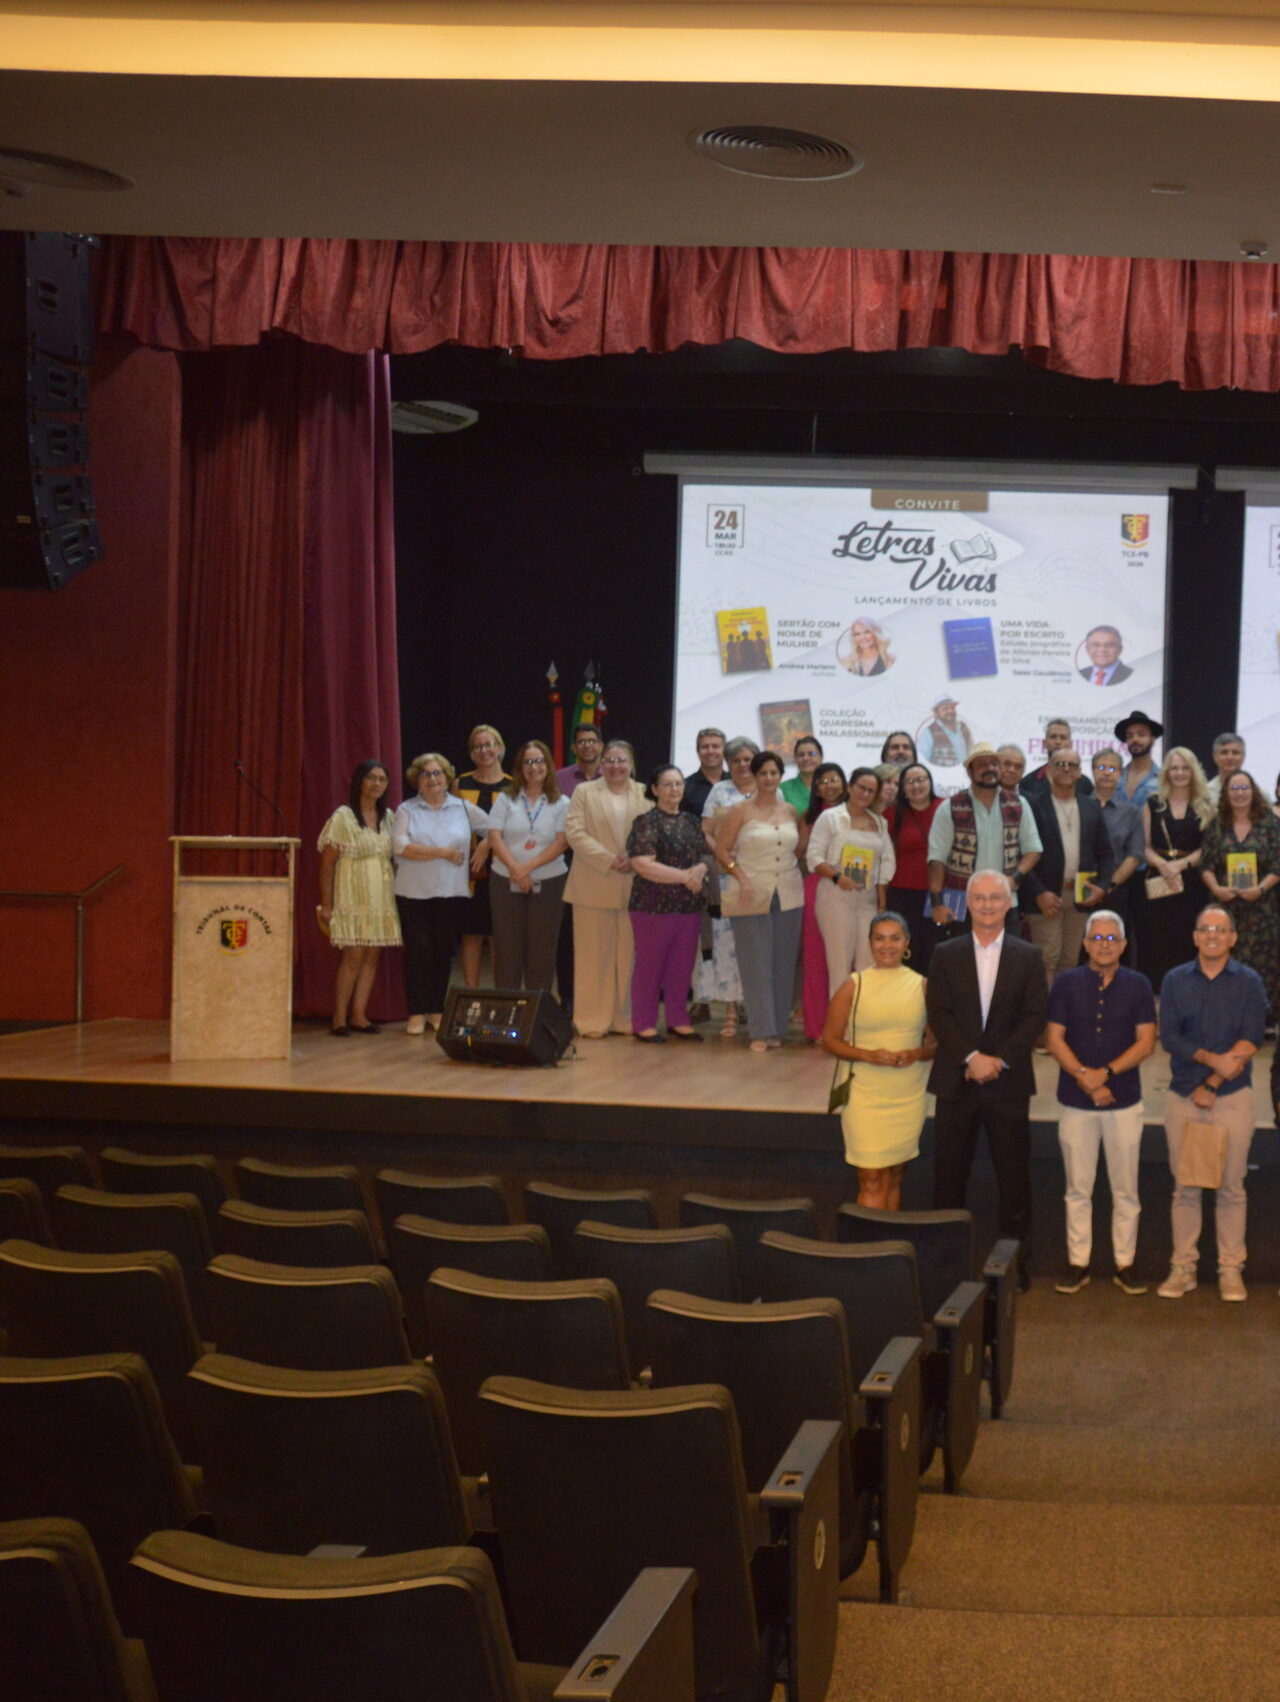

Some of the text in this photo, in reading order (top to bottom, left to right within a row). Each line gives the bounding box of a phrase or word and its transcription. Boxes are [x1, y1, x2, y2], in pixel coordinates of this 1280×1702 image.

[895, 498, 961, 511] CONVITE
[713, 509, 739, 531] 24
[714, 532, 737, 541] MAR
[832, 520, 936, 561] Letras
[890, 555, 998, 593] Vivas
[854, 596, 998, 608] LANÇAMENTO DE LIVROS
[776, 618, 841, 628] SERTÃO COM
[1000, 619, 1050, 629] UMA VIDA
[776, 630, 823, 639] NOME DE
[1000, 630, 1065, 640] POR ESCRITO
[776, 640, 819, 649] MULHER
[819, 719, 875, 729] QUARESMA
[196, 904, 272, 935] TRIBUNAL DE CONTAS
